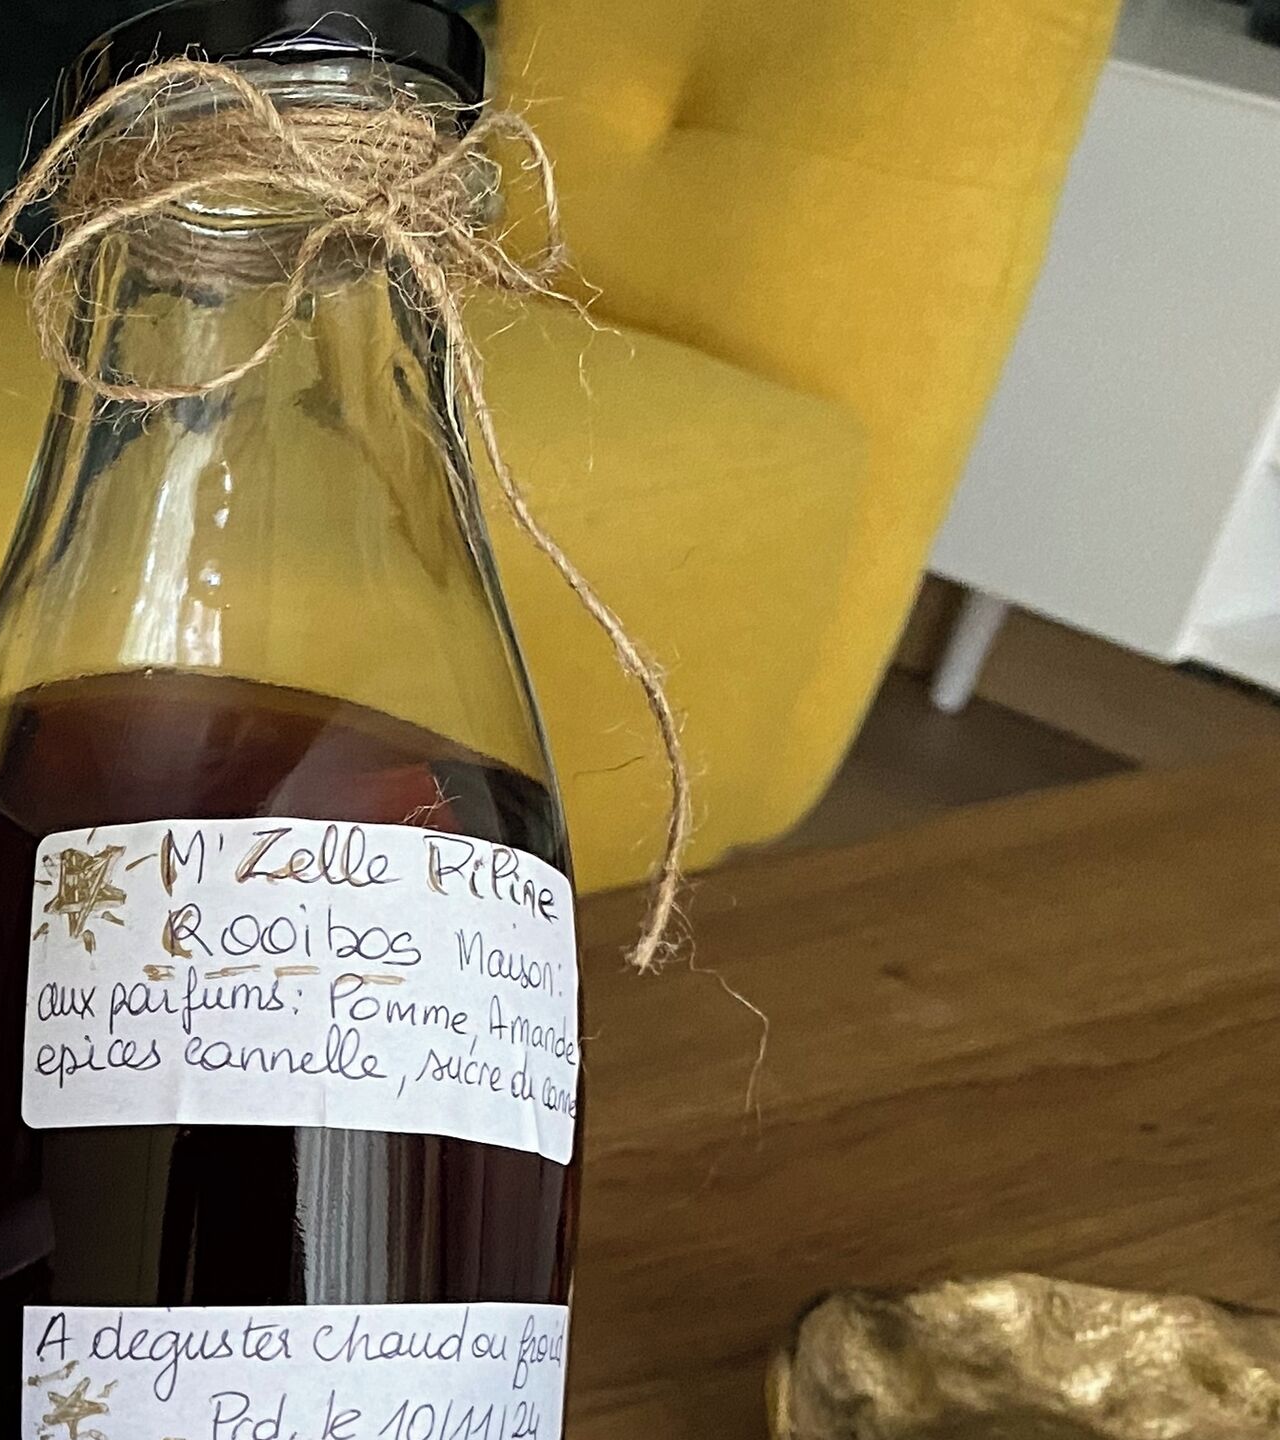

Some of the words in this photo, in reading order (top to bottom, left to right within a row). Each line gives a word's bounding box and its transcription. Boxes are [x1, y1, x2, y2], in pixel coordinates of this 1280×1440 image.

[160, 824, 402, 896] M'Zelle
[162, 903, 422, 965] Rooibos
[37, 982, 96, 1021] aux
[415, 1049, 505, 1091] sucre
[37, 1312, 73, 1360] A
[472, 1333, 506, 1360] ou
[322, 1390, 361, 1440] le
